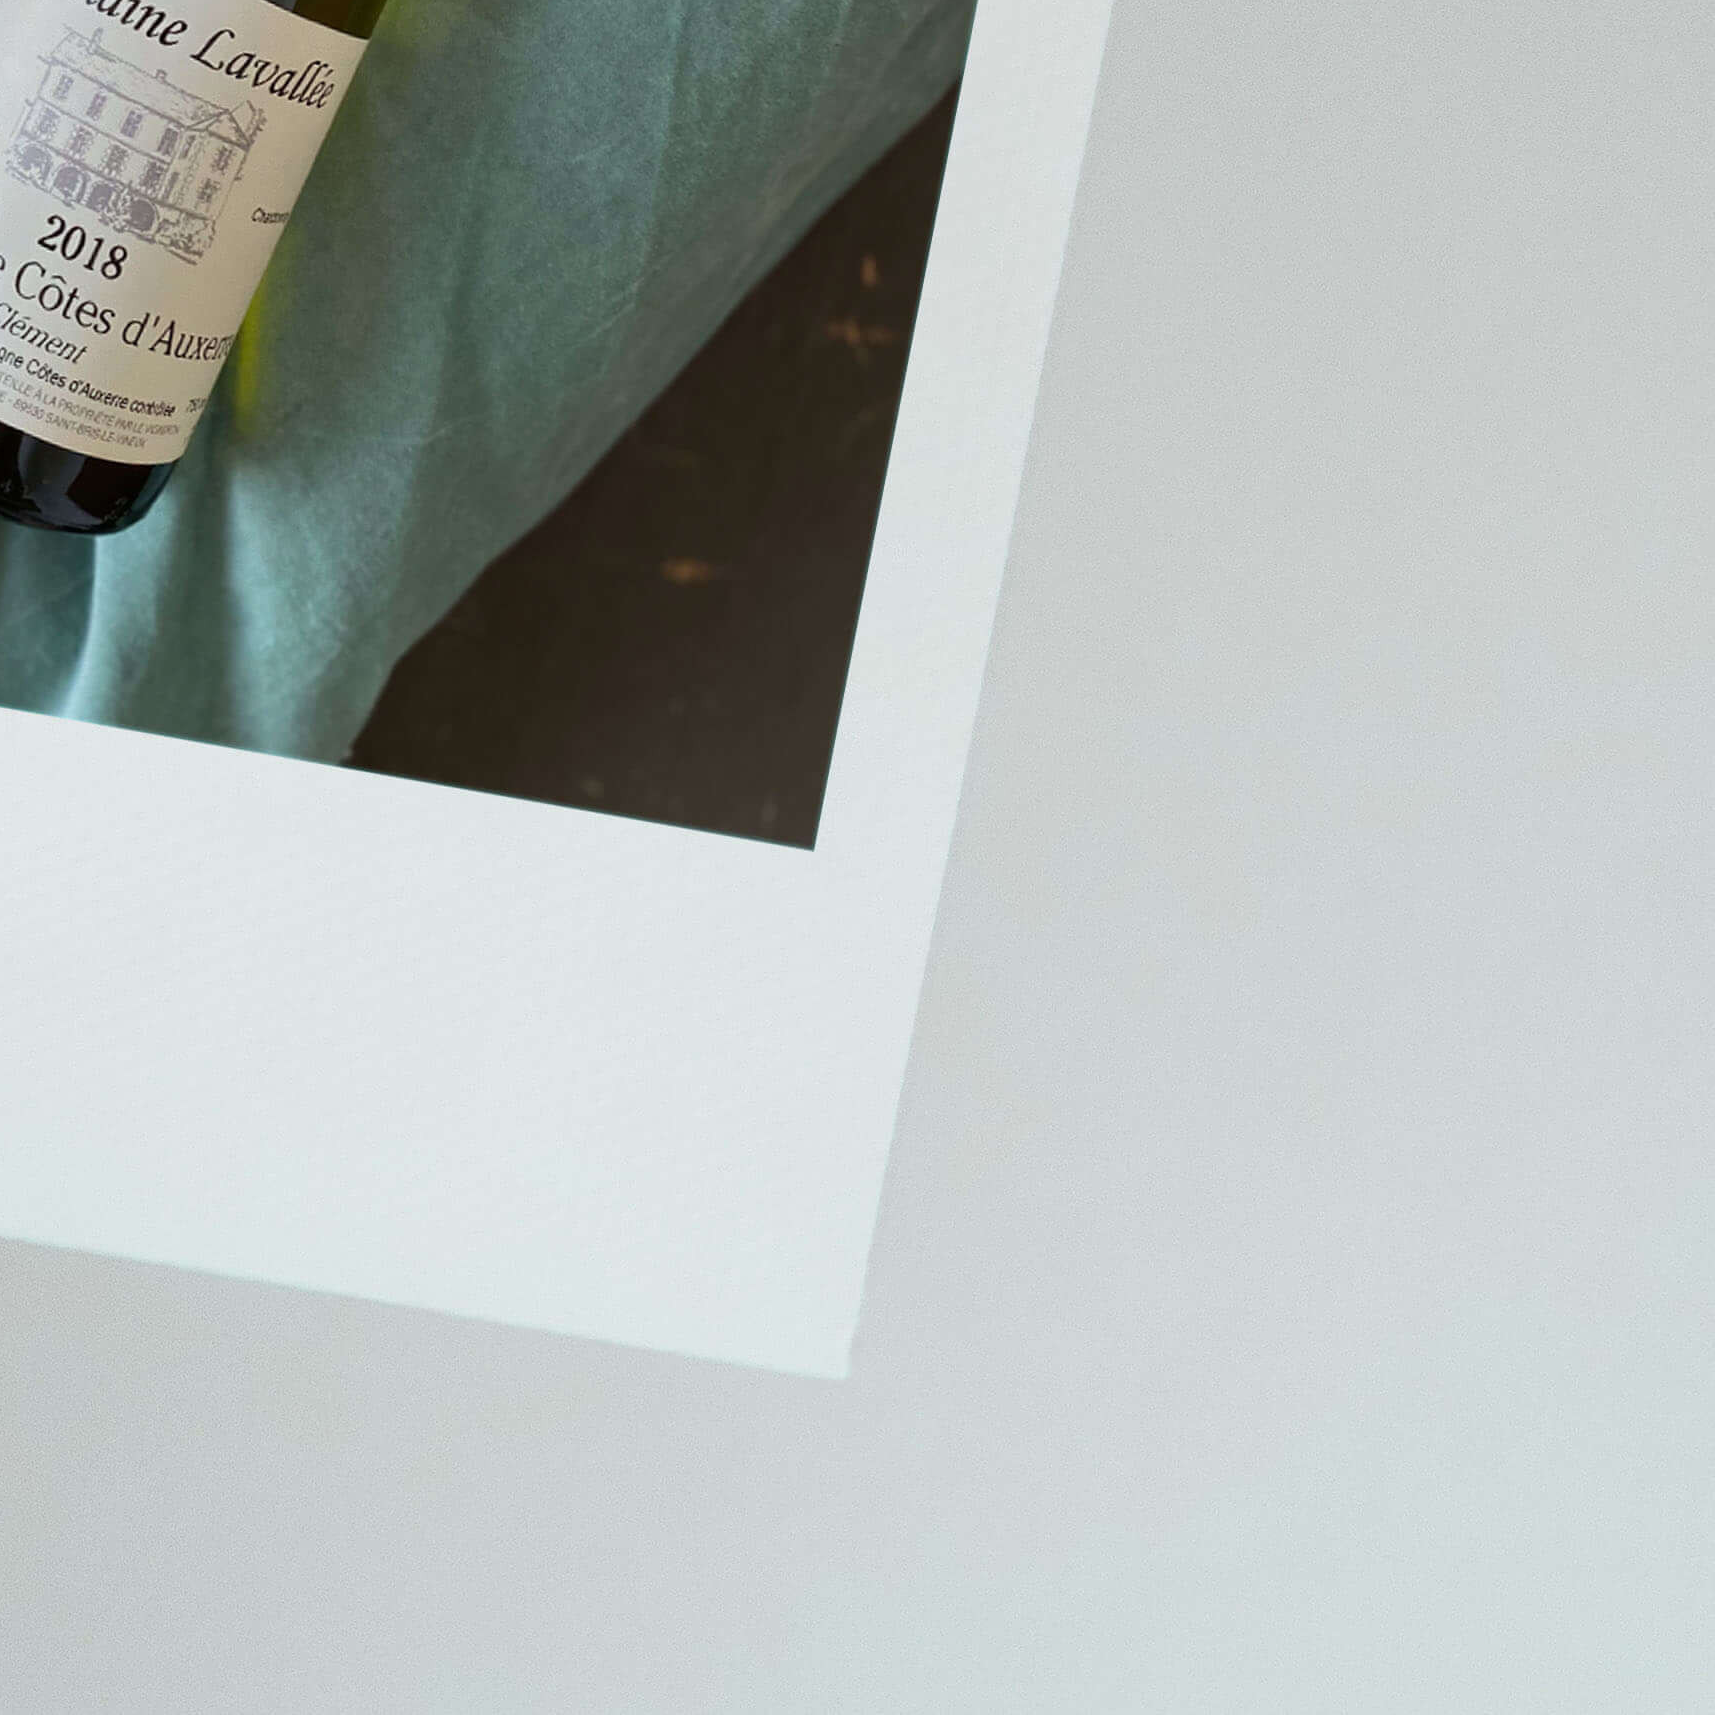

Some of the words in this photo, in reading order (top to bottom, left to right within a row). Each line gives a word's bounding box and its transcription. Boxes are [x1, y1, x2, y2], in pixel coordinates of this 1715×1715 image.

[189, 28, 336, 109] Lavallée
[37, 215, 128, 280] 2018
[14, 260, 117, 335] Côtes
[26, 357, 68, 389] Côtes
[69, 379, 130, 411] d'Auxerre
